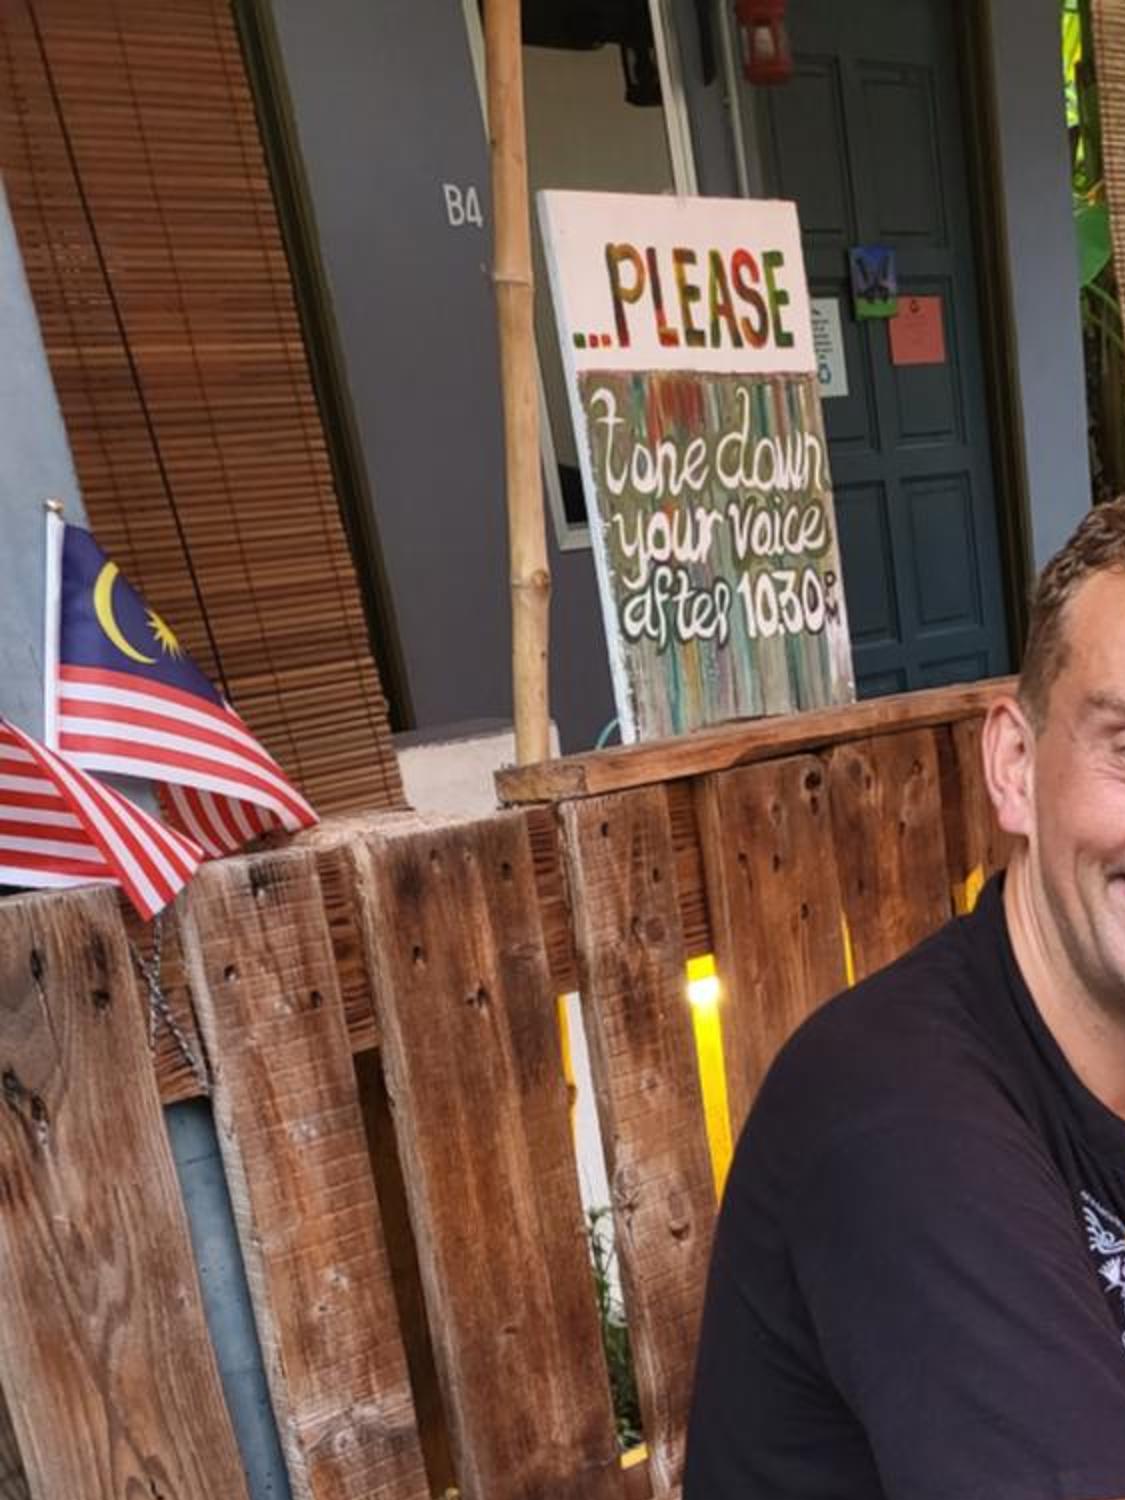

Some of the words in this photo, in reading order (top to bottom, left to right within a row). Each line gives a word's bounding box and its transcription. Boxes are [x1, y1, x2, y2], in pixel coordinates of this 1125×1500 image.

[442, 183, 483, 228] B4
[715, 386, 823, 492] down
[613, 506, 724, 590] your
[623, 565, 730, 646] after
